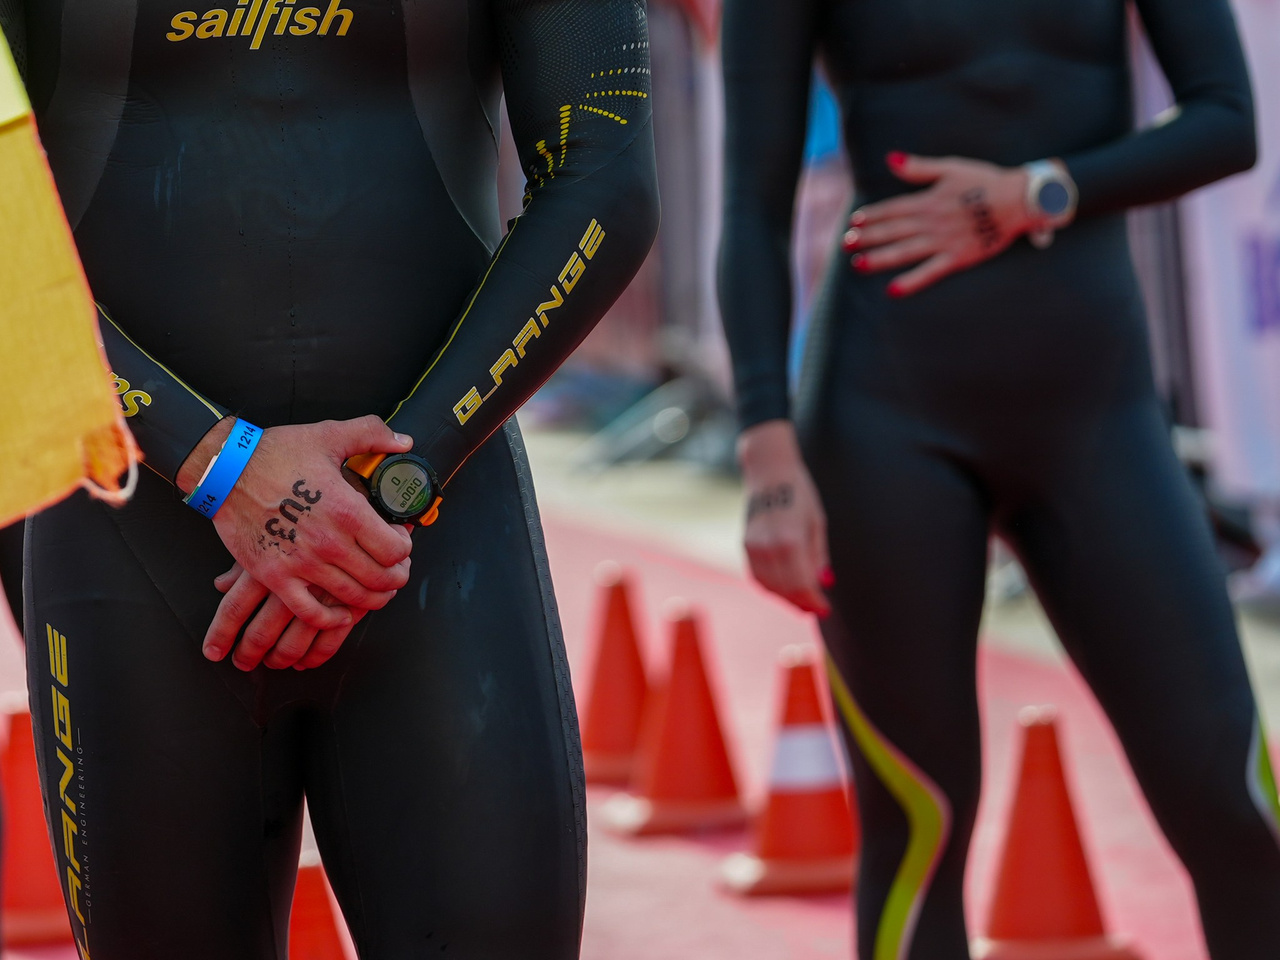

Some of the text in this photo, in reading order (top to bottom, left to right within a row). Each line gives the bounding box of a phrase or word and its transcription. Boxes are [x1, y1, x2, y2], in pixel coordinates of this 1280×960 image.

[237, 425, 256, 450] 1214
[46, 623, 91, 960] _RANGE
[76, 746, 92, 907] GERMAN ENGINEERING
